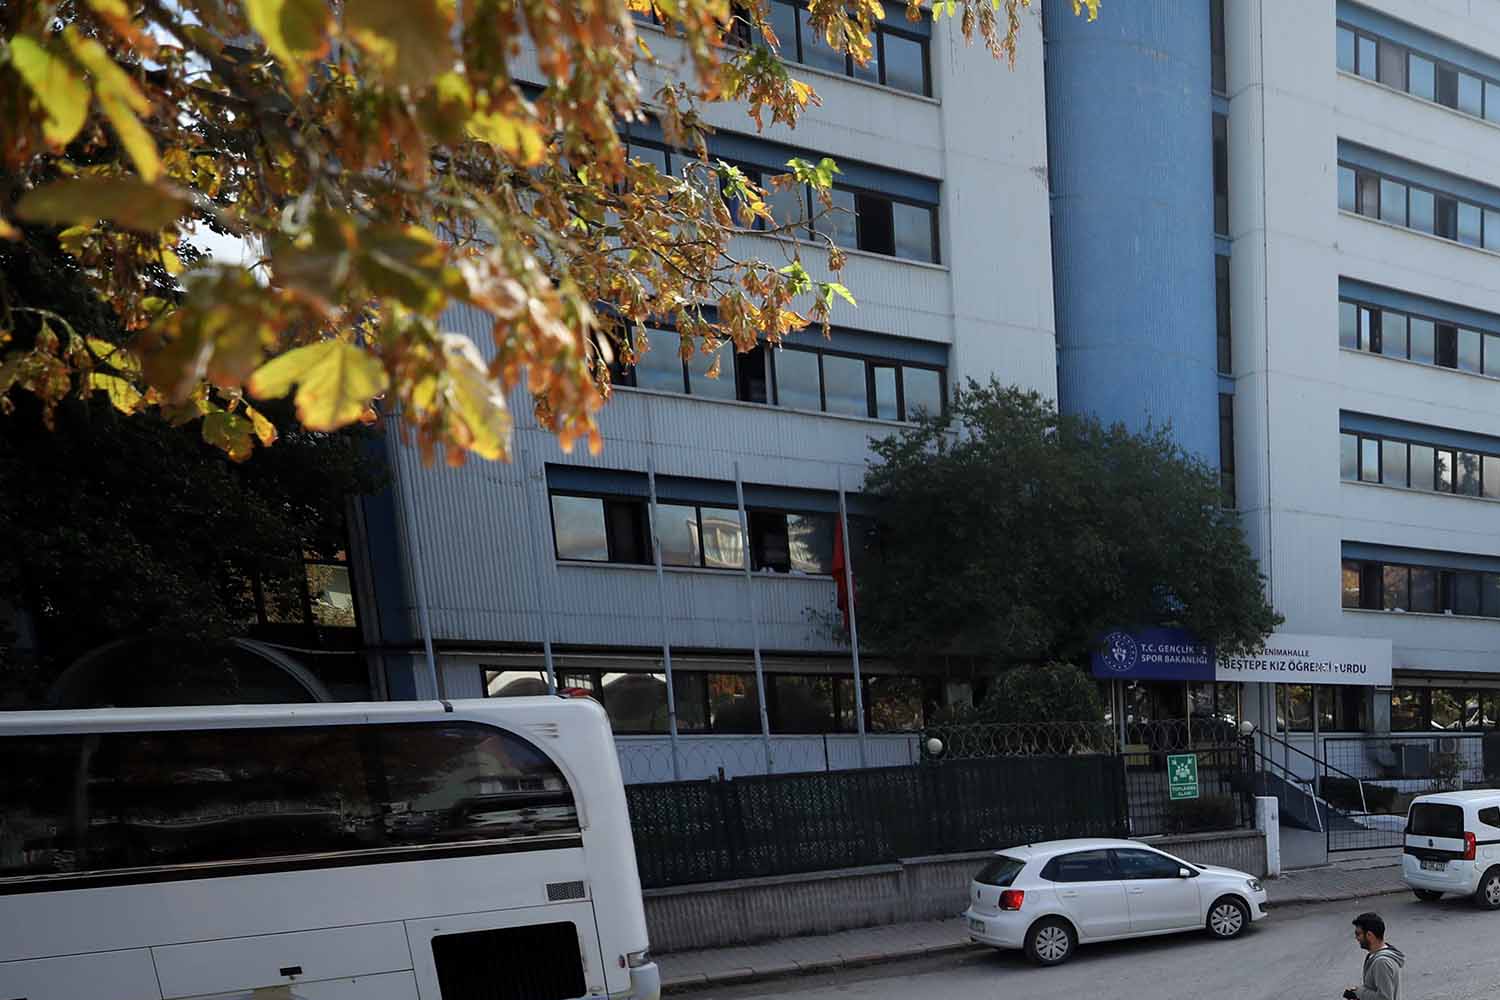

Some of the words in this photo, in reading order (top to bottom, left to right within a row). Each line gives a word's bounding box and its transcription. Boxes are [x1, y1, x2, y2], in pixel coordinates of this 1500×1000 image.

[1141, 654, 1163, 662] SPOR
[1223, 659, 1267, 672] BEŞTEPE
[1270, 661, 1286, 671] KIZ
